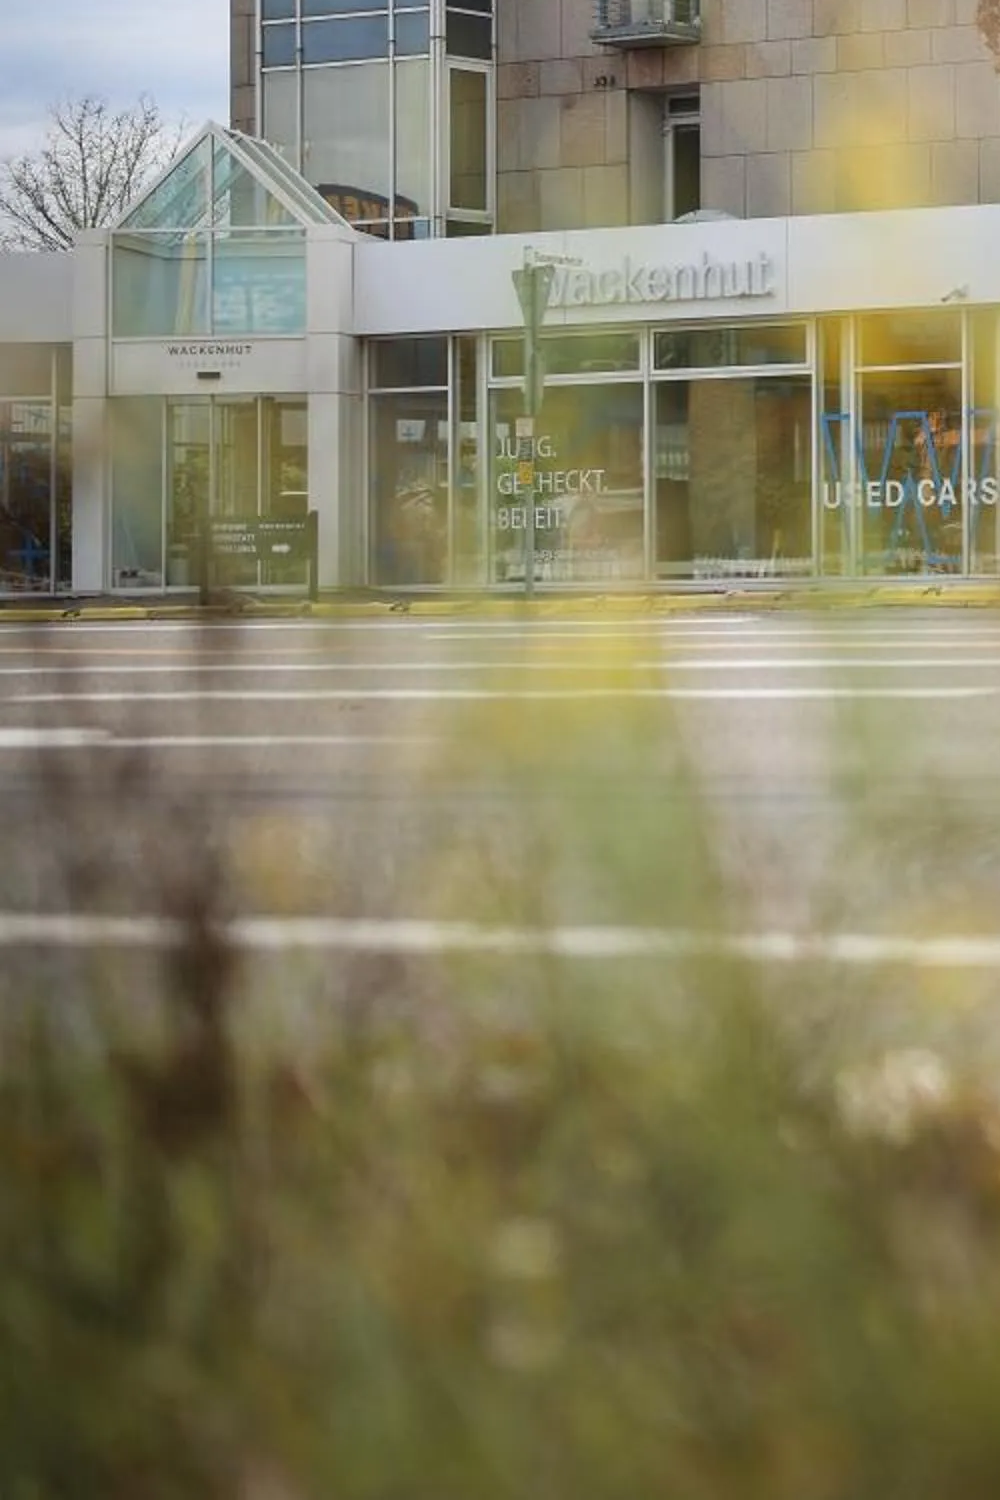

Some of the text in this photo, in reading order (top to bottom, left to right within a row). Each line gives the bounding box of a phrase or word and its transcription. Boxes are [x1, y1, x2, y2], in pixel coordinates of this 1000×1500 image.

[167, 345, 252, 356] WACKENHUT
[496, 435, 557, 459] JUG.
[497, 469, 608, 495] GEHECKT.
[917, 477, 999, 507] CARS
